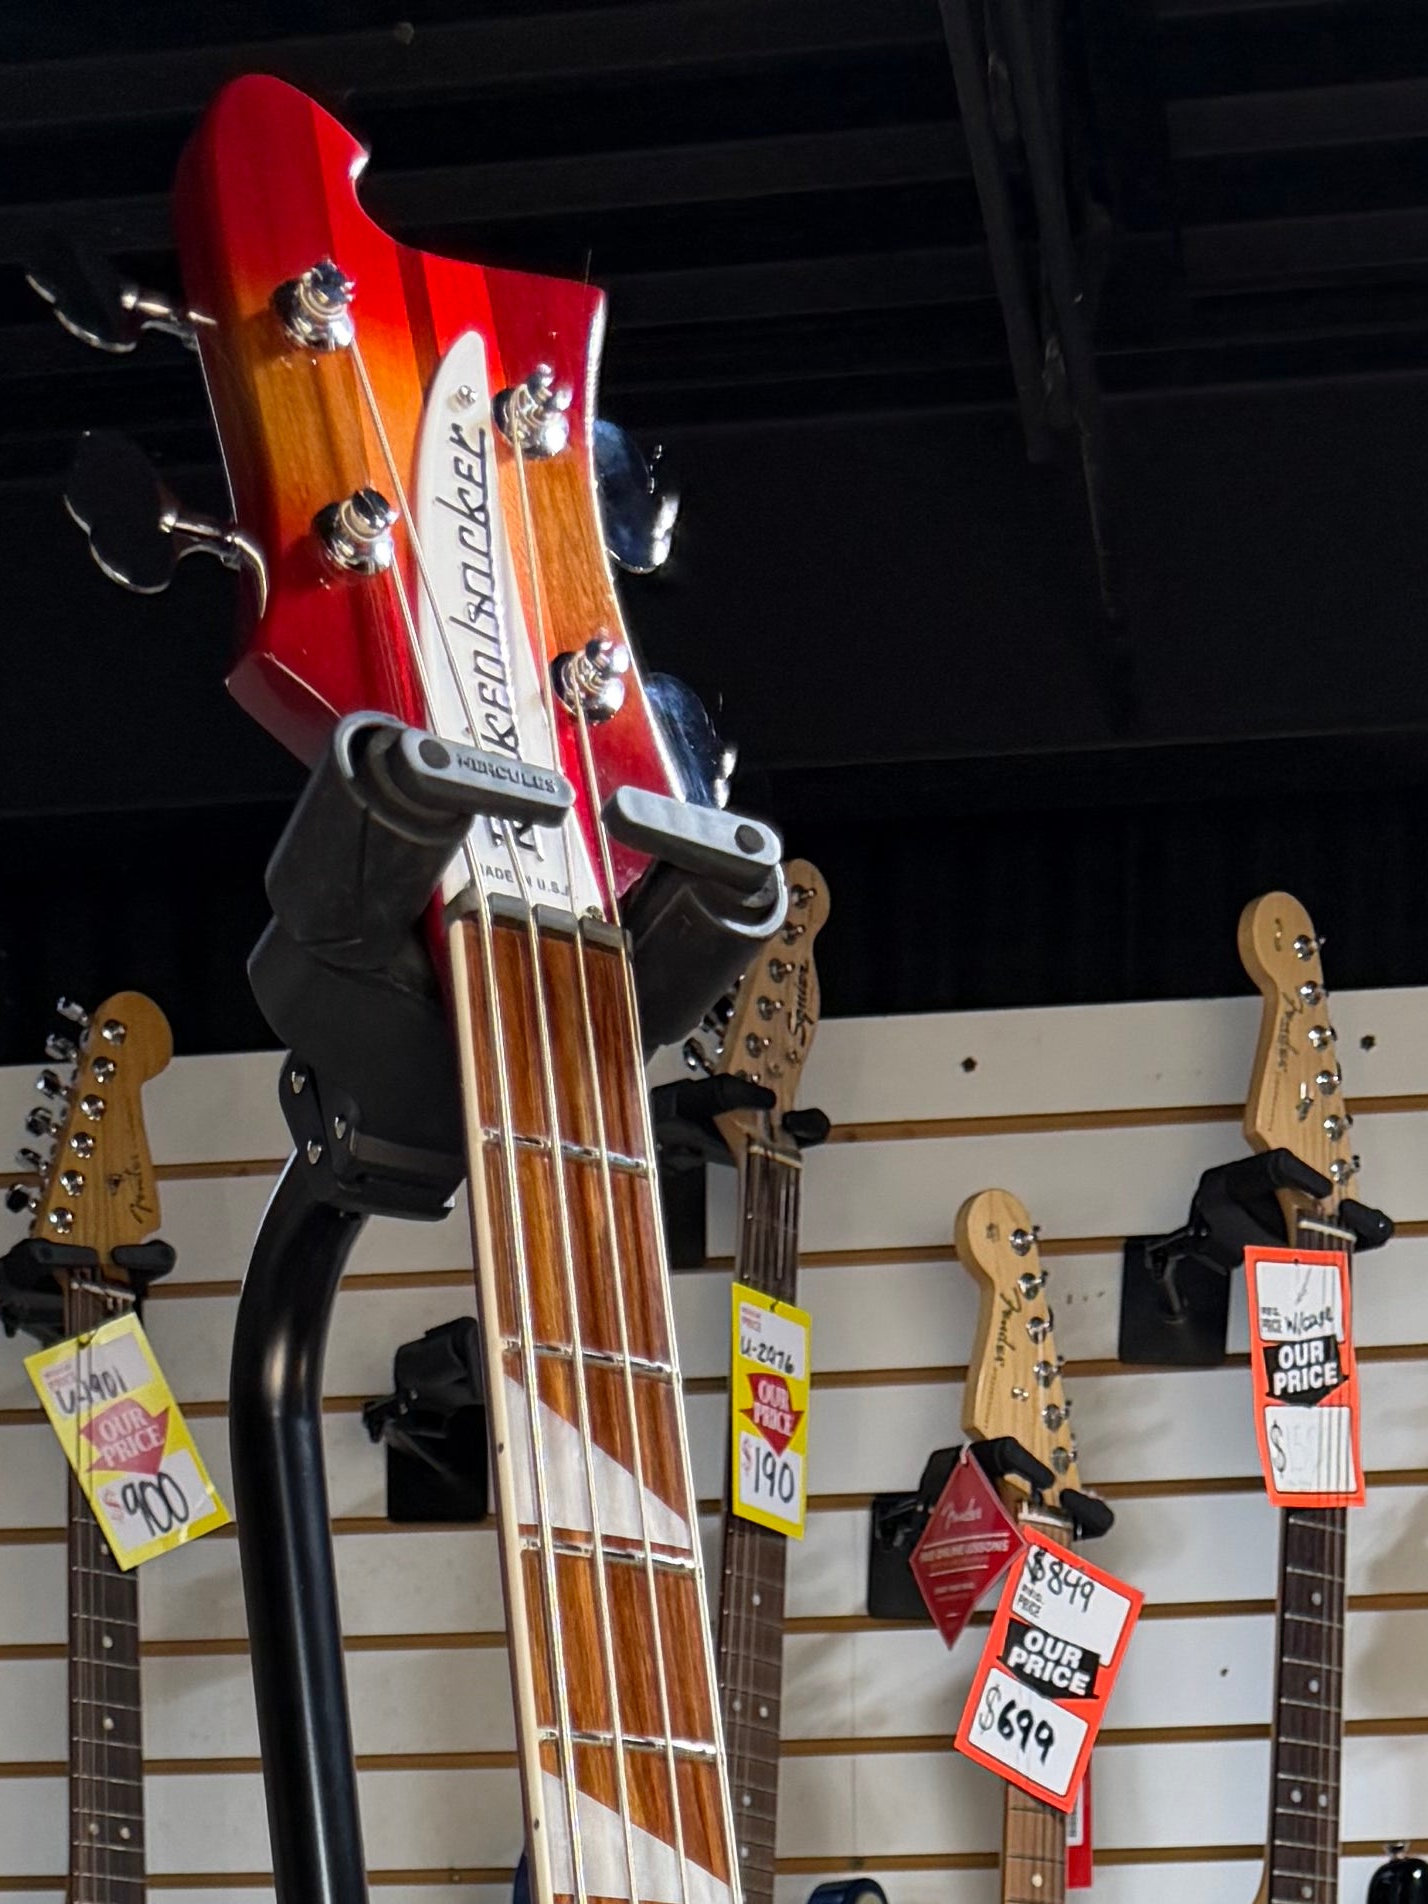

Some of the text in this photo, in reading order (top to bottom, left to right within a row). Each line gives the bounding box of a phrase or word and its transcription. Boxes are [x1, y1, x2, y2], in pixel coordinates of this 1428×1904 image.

[1278, 1340, 1324, 1369] OUR
[757, 1379, 790, 1412] OUR
[1273, 1362, 1339, 1396] PRICE
[98, 1405, 149, 1443] OUR
[753, 1402, 794, 1437] PRICE
[99, 1423, 165, 1468] PRICE
[741, 1438, 795, 1504] $190
[104, 1471, 189, 1537] $900
[1024, 1548, 1095, 1613] $849
[1022, 1629, 1083, 1670] OUR
[1007, 1646, 1092, 1697] PRICE
[978, 1684, 1056, 1765] $699
